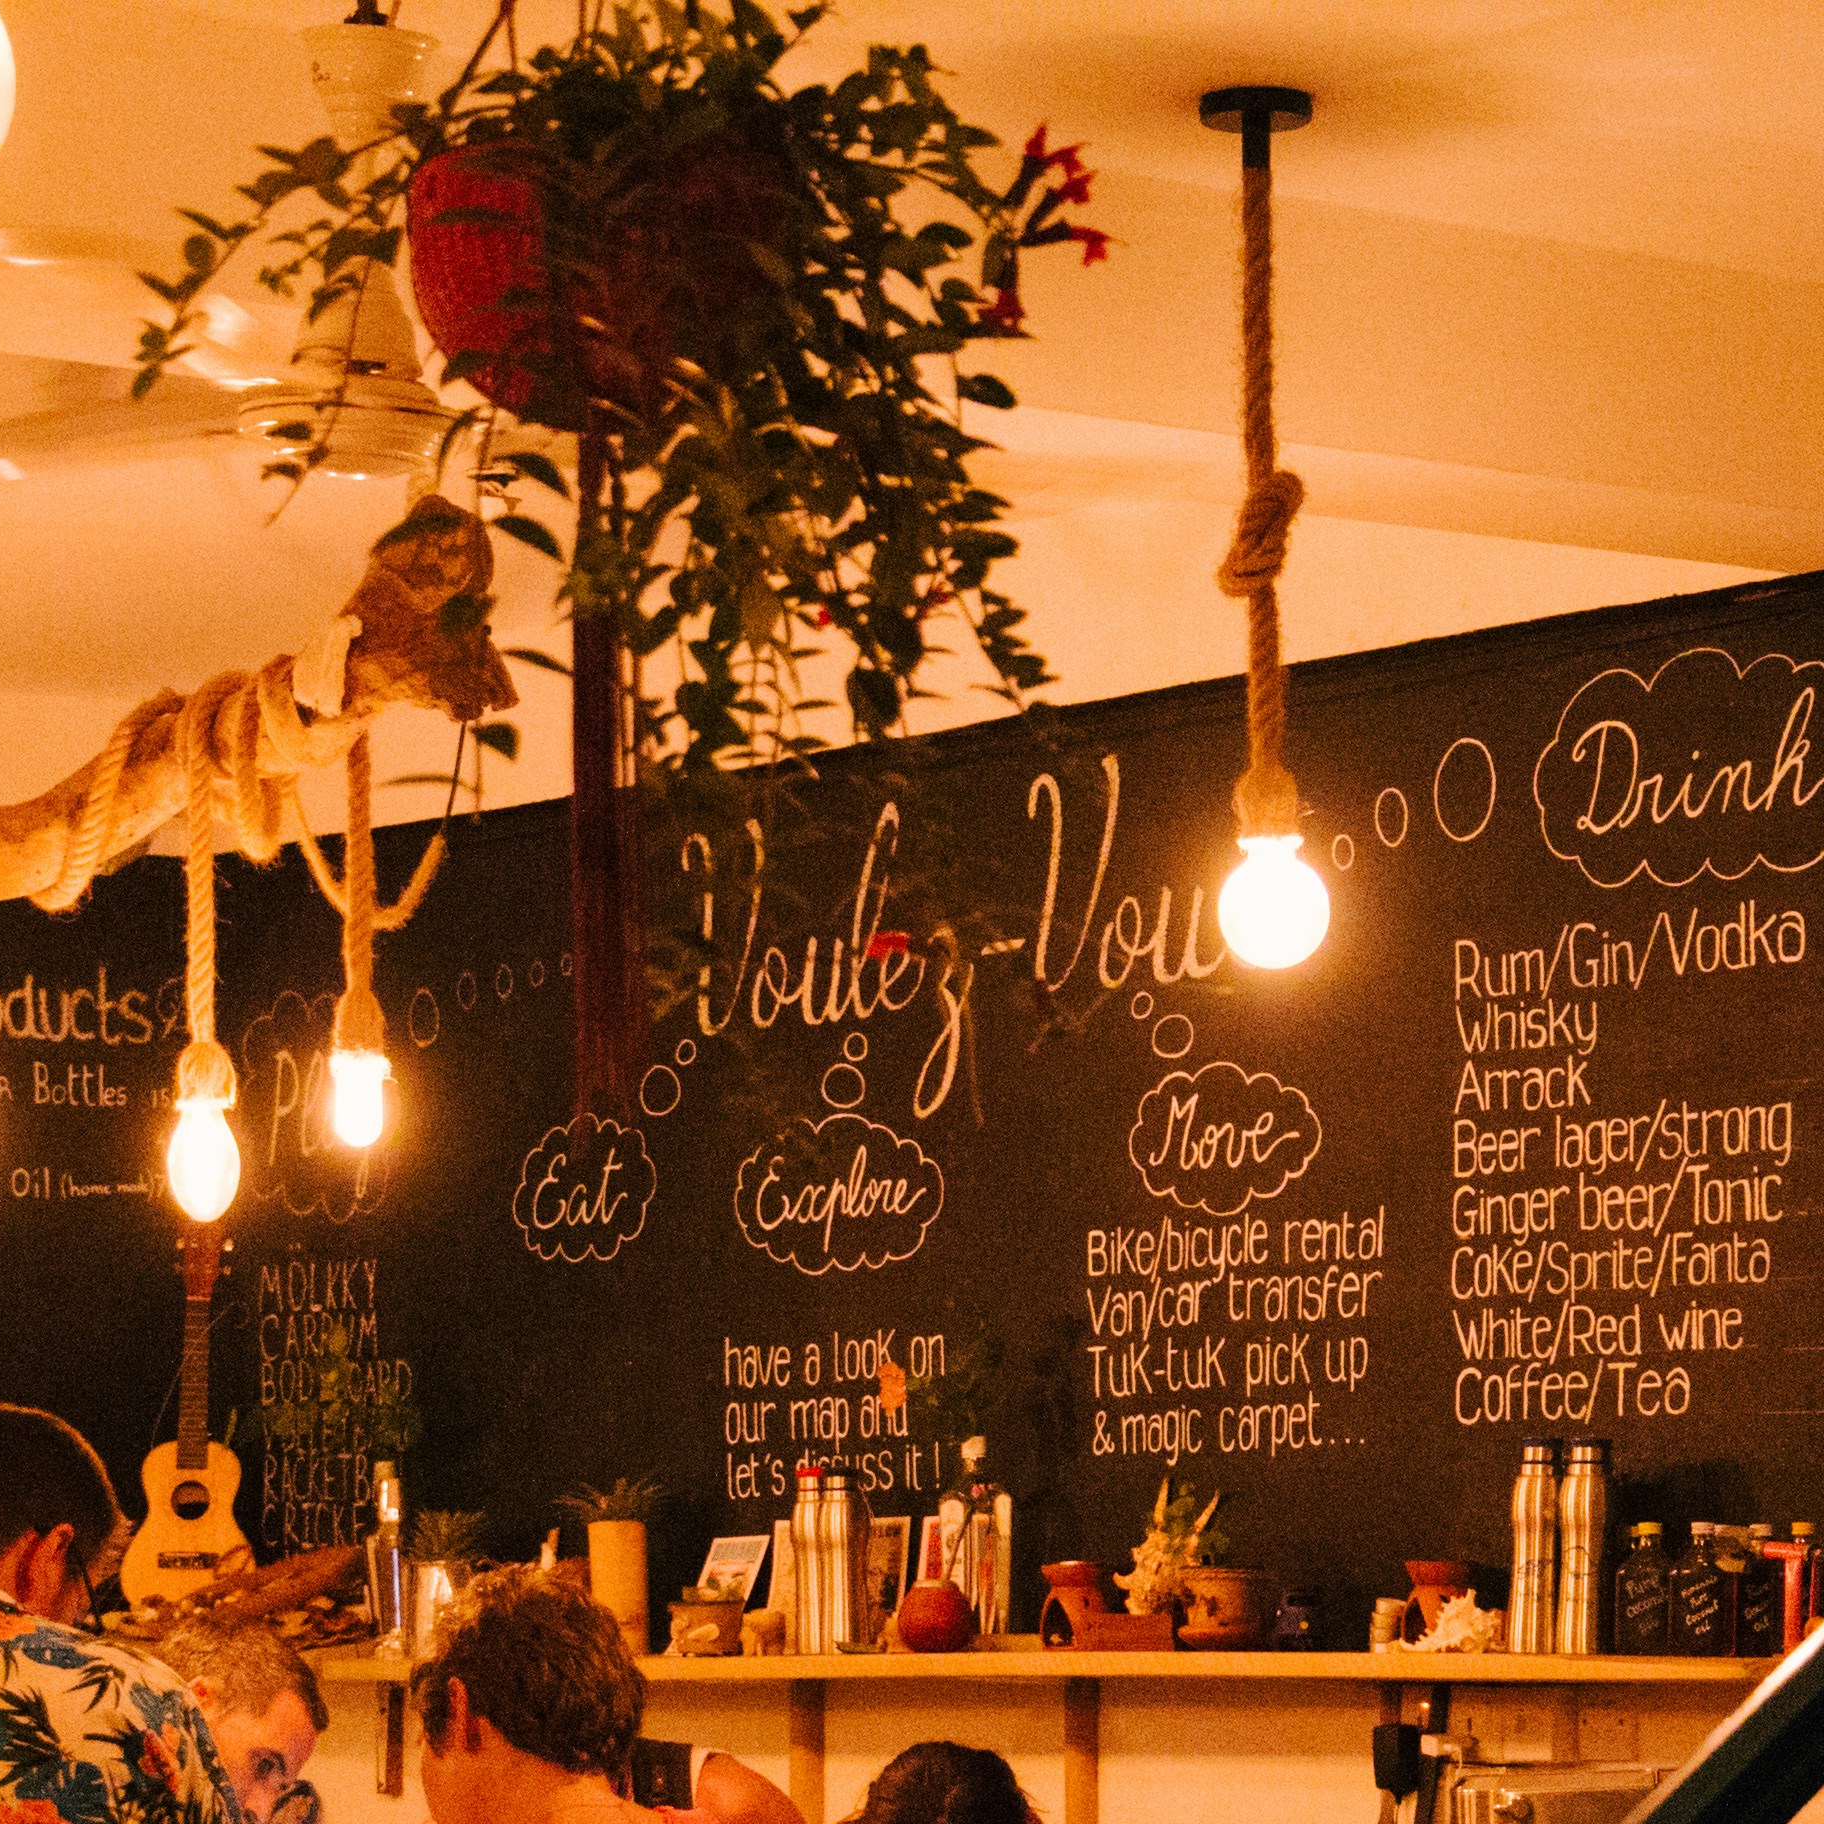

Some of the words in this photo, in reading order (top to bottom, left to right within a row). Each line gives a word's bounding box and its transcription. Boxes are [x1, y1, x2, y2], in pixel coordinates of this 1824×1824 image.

[681, 753, 1224, 1119] Voulez-Vou
[1454, 900, 1806, 1000] Rum/Gin/Vodka
[1455, 1000, 1598, 1055] Whisky
[33, 1061, 127, 1107] Bottles
[1454, 1055, 1592, 1114] Arrack
[1149, 1093, 1301, 1172] Move
[1454, 1119, 1540, 1179] Beer
[1555, 1098, 1792, 1175] lager/strong
[12, 1167, 51, 1199] Oil
[532, 1147, 629, 1232] Eat
[756, 1145, 927, 1253] Explore
[1452, 1182, 1570, 1247] Ginger
[1579, 1156, 1783, 1237] beer/Tonic
[1086, 1215, 1270, 1284] Bike/bicycle
[1283, 1205, 1385, 1264] rental
[1451, 1231, 1771, 1303] Coke/Sprite/Fanta
[1086, 1277, 1202, 1342] Van/car
[1229, 1264, 1384, 1323] transfer
[1452, 1299, 1642, 1364] White/Red
[1658, 1301, 1744, 1352] wine
[724, 1336, 792, 1389] have
[804, 1343, 821, 1386] a
[833, 1328, 897, 1382] look
[910, 1334, 945, 1377] on
[1247, 1332, 1311, 1397] pick
[1326, 1336, 1370, 1392] up
[725, 1402, 777, 1445] our
[790, 1396, 850, 1454] map
[860, 1395, 908, 1439] and
[1455, 1360, 1692, 1426] Coffee/Tea
[1092, 1410, 1116, 1456] &
[1121, 1405, 1203, 1466] magic
[727, 1452, 786, 1500] let's
[906, 1443, 922, 1491] it
